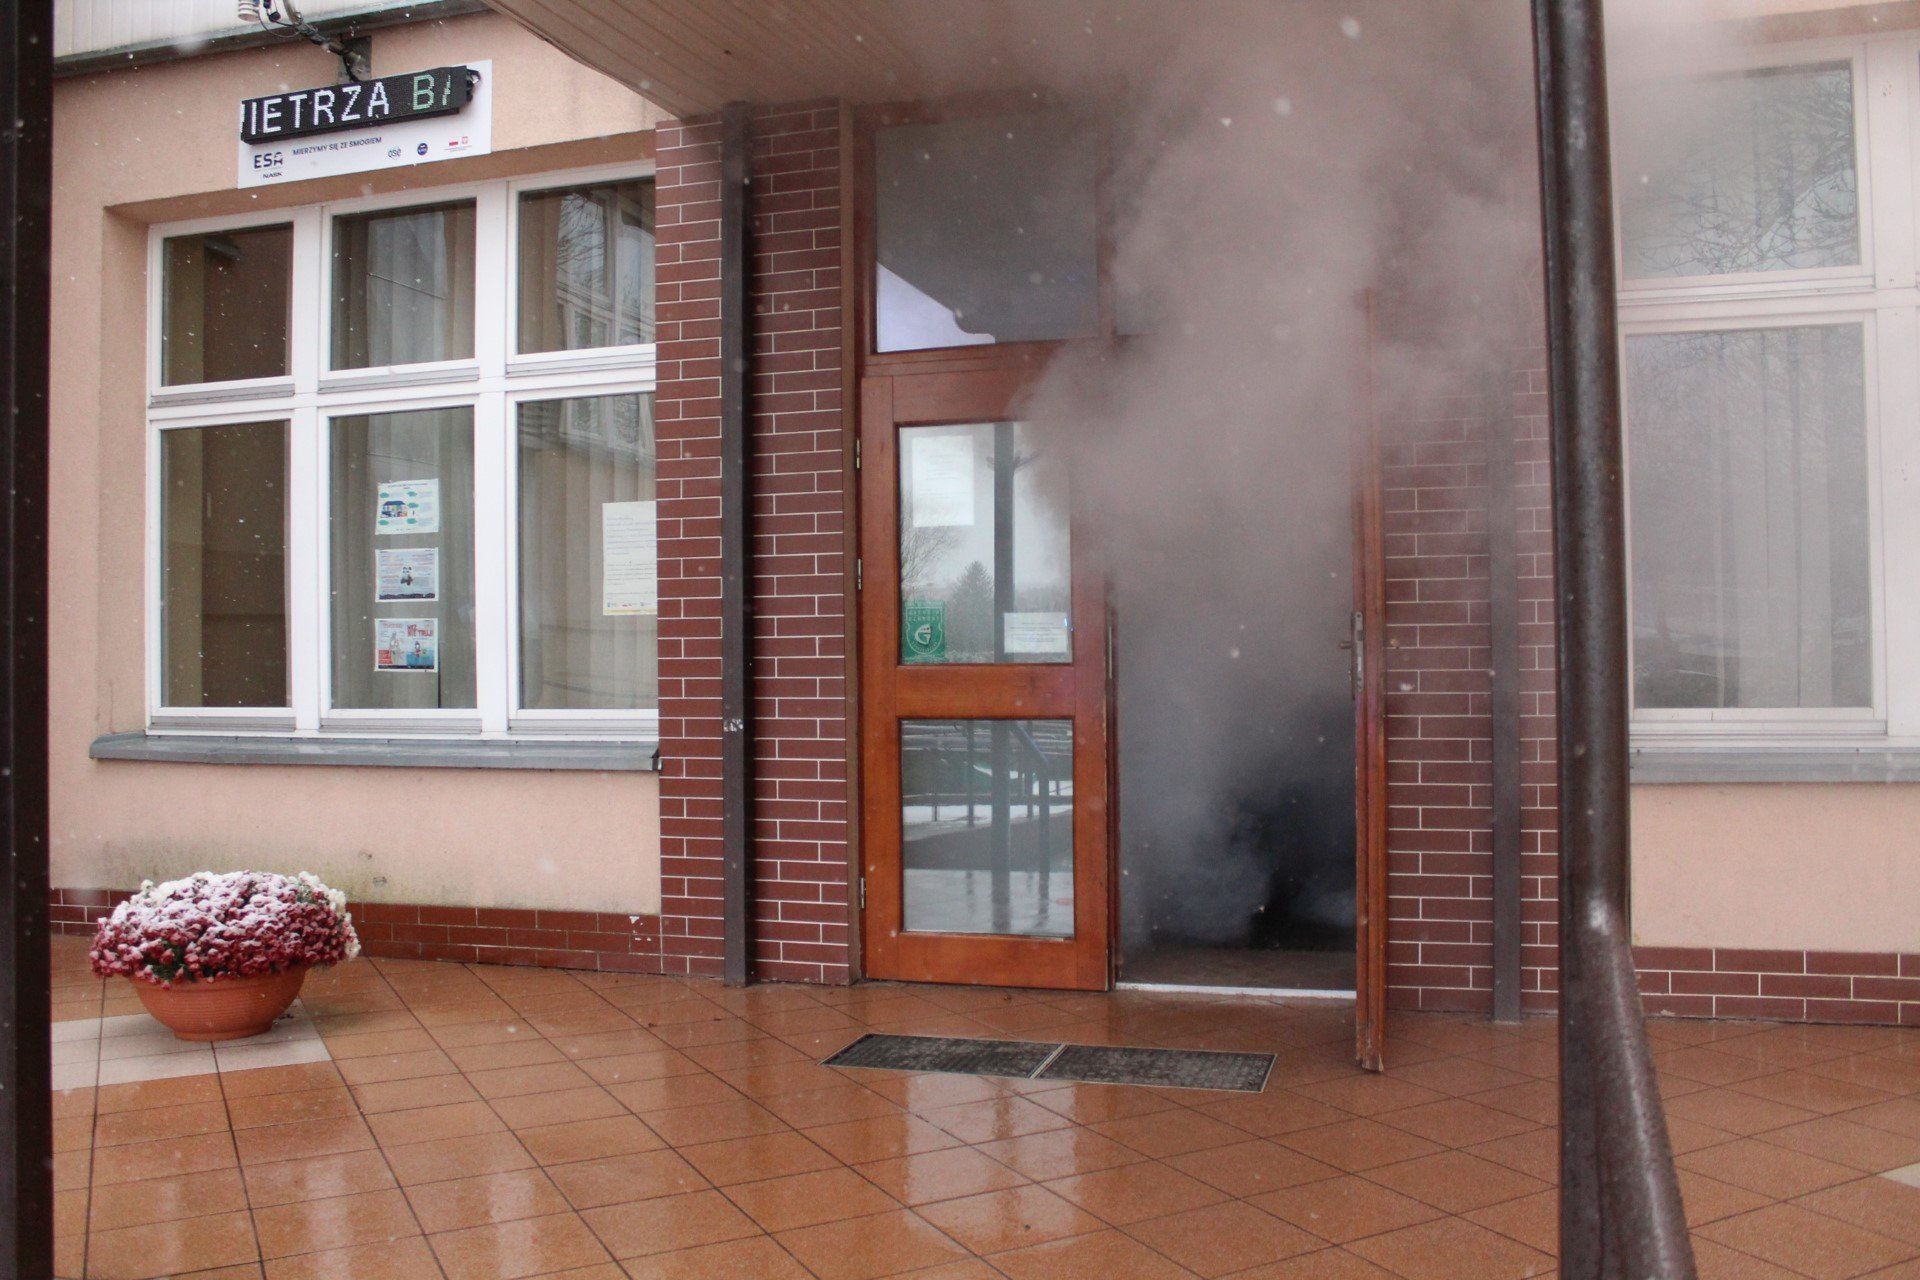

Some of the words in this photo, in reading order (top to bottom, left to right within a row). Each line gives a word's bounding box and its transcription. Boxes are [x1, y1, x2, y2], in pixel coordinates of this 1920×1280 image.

[240, 81, 389, 135] IETRZA
[292, 145, 328, 156] MIERZYMY
[349, 137, 382, 148] SMOGIEM
[254, 151, 284, 169] ESA
